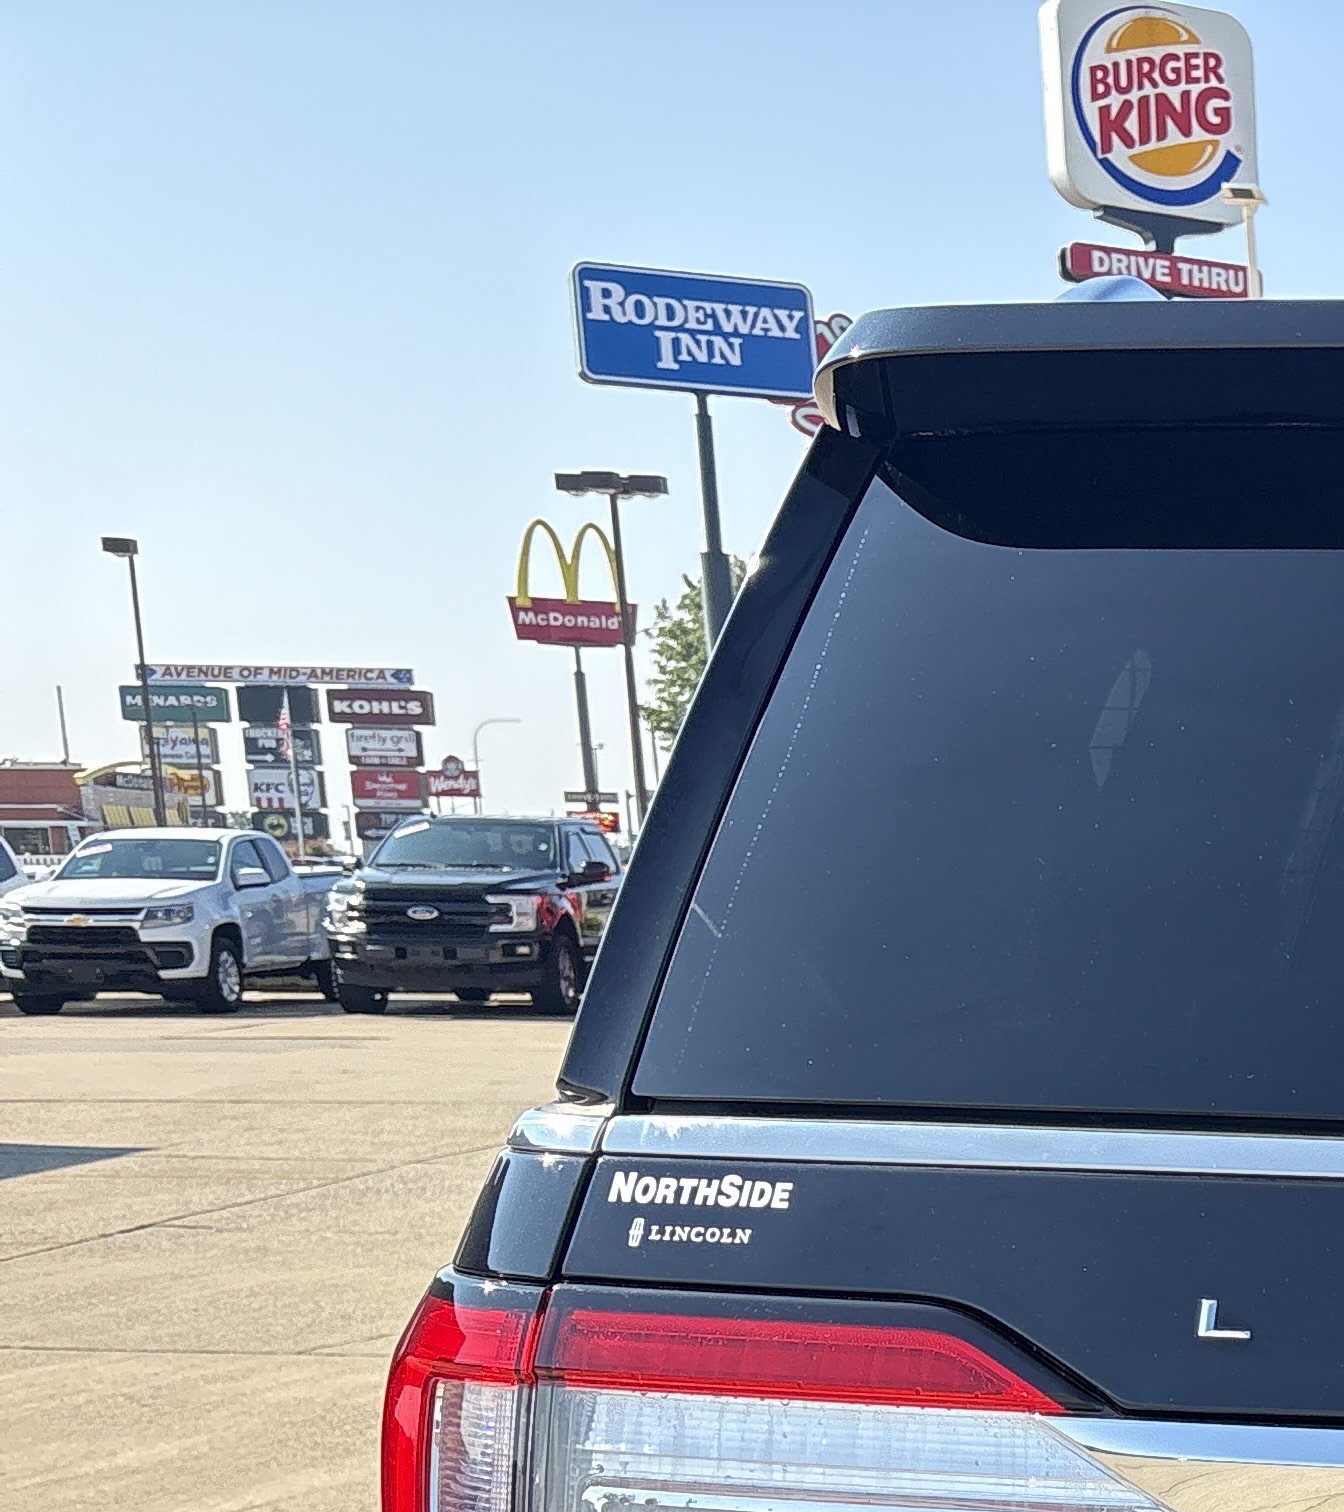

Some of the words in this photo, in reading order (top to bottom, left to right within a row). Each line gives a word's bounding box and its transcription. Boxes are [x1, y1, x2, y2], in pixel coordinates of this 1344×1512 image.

[1088, 51, 1226, 103] BURGER
[1097, 86, 1233, 156] KING
[1091, 250, 1173, 281] DRIVE
[1176, 261, 1245, 294] THRU
[582, 279, 805, 340] RODEWAY
[653, 329, 744, 371] INN
[517, 610, 624, 630] McDonald'
[161, 665, 235, 679] AVENUE
[238, 666, 263, 679] OF
[268, 667, 388, 682] MID-AMERICA
[332, 699, 423, 715] KOHL'S
[253, 782, 285, 793] KFC
[647, 1225, 753, 1245] LINCOLN
